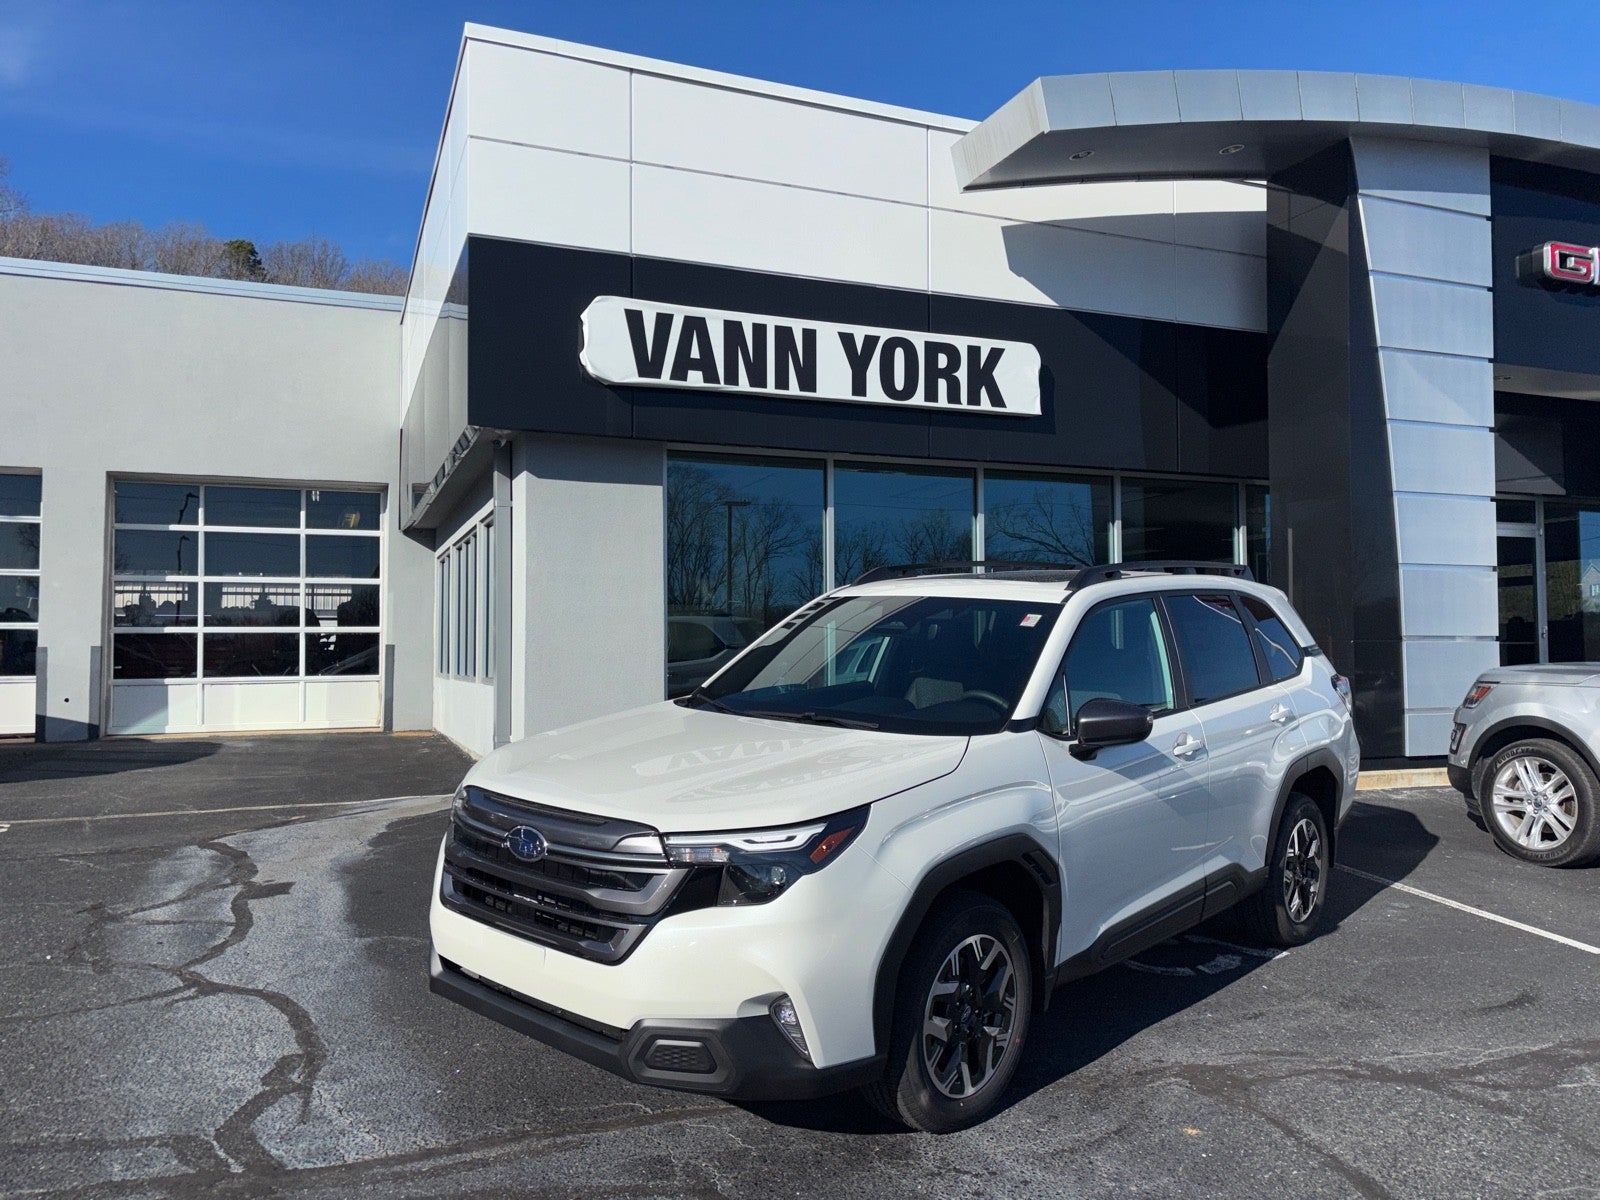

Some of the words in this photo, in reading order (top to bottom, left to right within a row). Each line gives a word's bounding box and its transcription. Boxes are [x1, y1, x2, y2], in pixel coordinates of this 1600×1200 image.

[1544, 241, 1600, 285] G
[624, 308, 817, 393] VANN
[837, 331, 1007, 408] YORK
